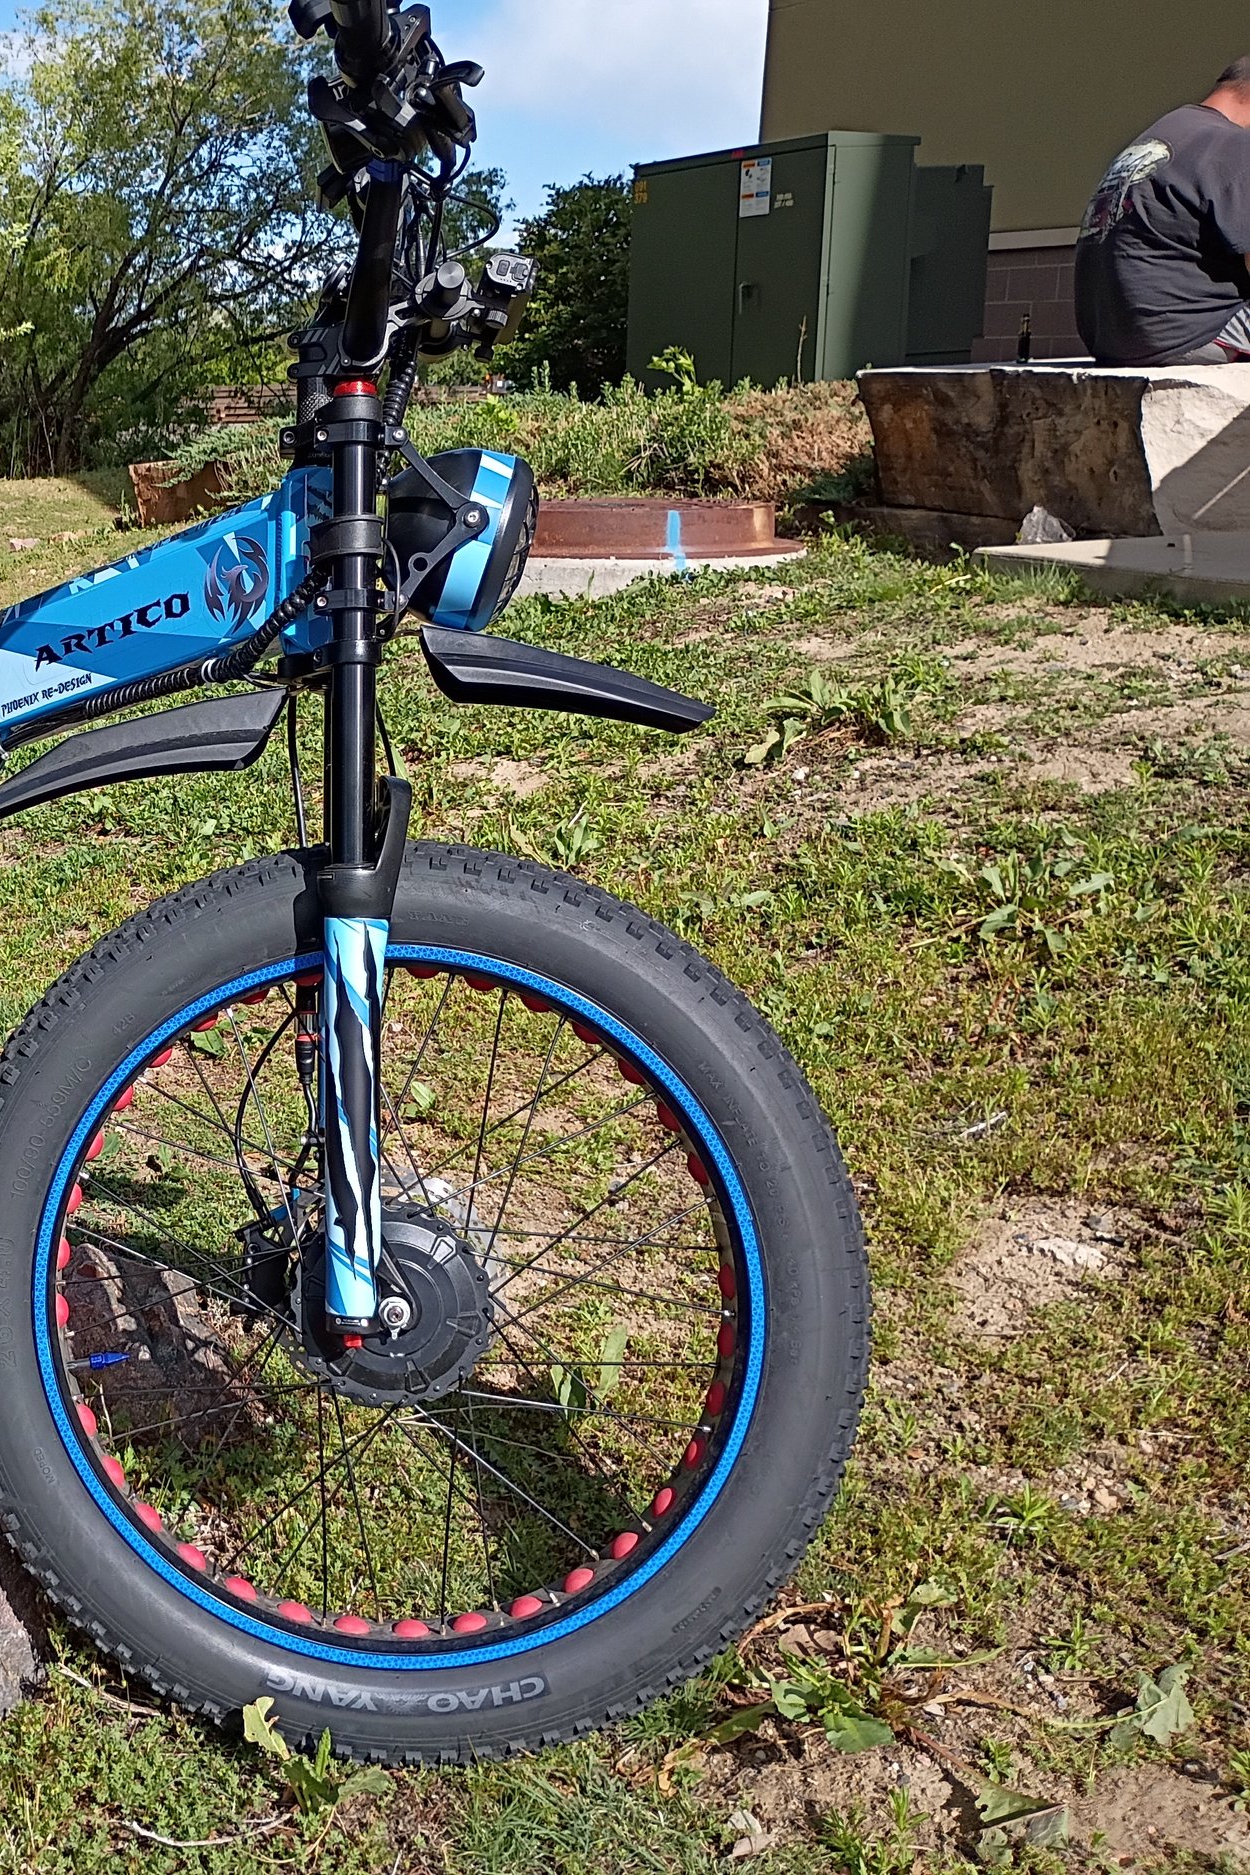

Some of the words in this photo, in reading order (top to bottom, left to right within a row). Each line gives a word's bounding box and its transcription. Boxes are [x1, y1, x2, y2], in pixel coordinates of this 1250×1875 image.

[35, 590, 191, 672] ARTICO
[0, 692, 40, 717] PHOENIX
[33, 1447, 56, 1485] MOPED
[265, 1666, 379, 1712] YANG
[427, 1676, 546, 1714] CHAO
